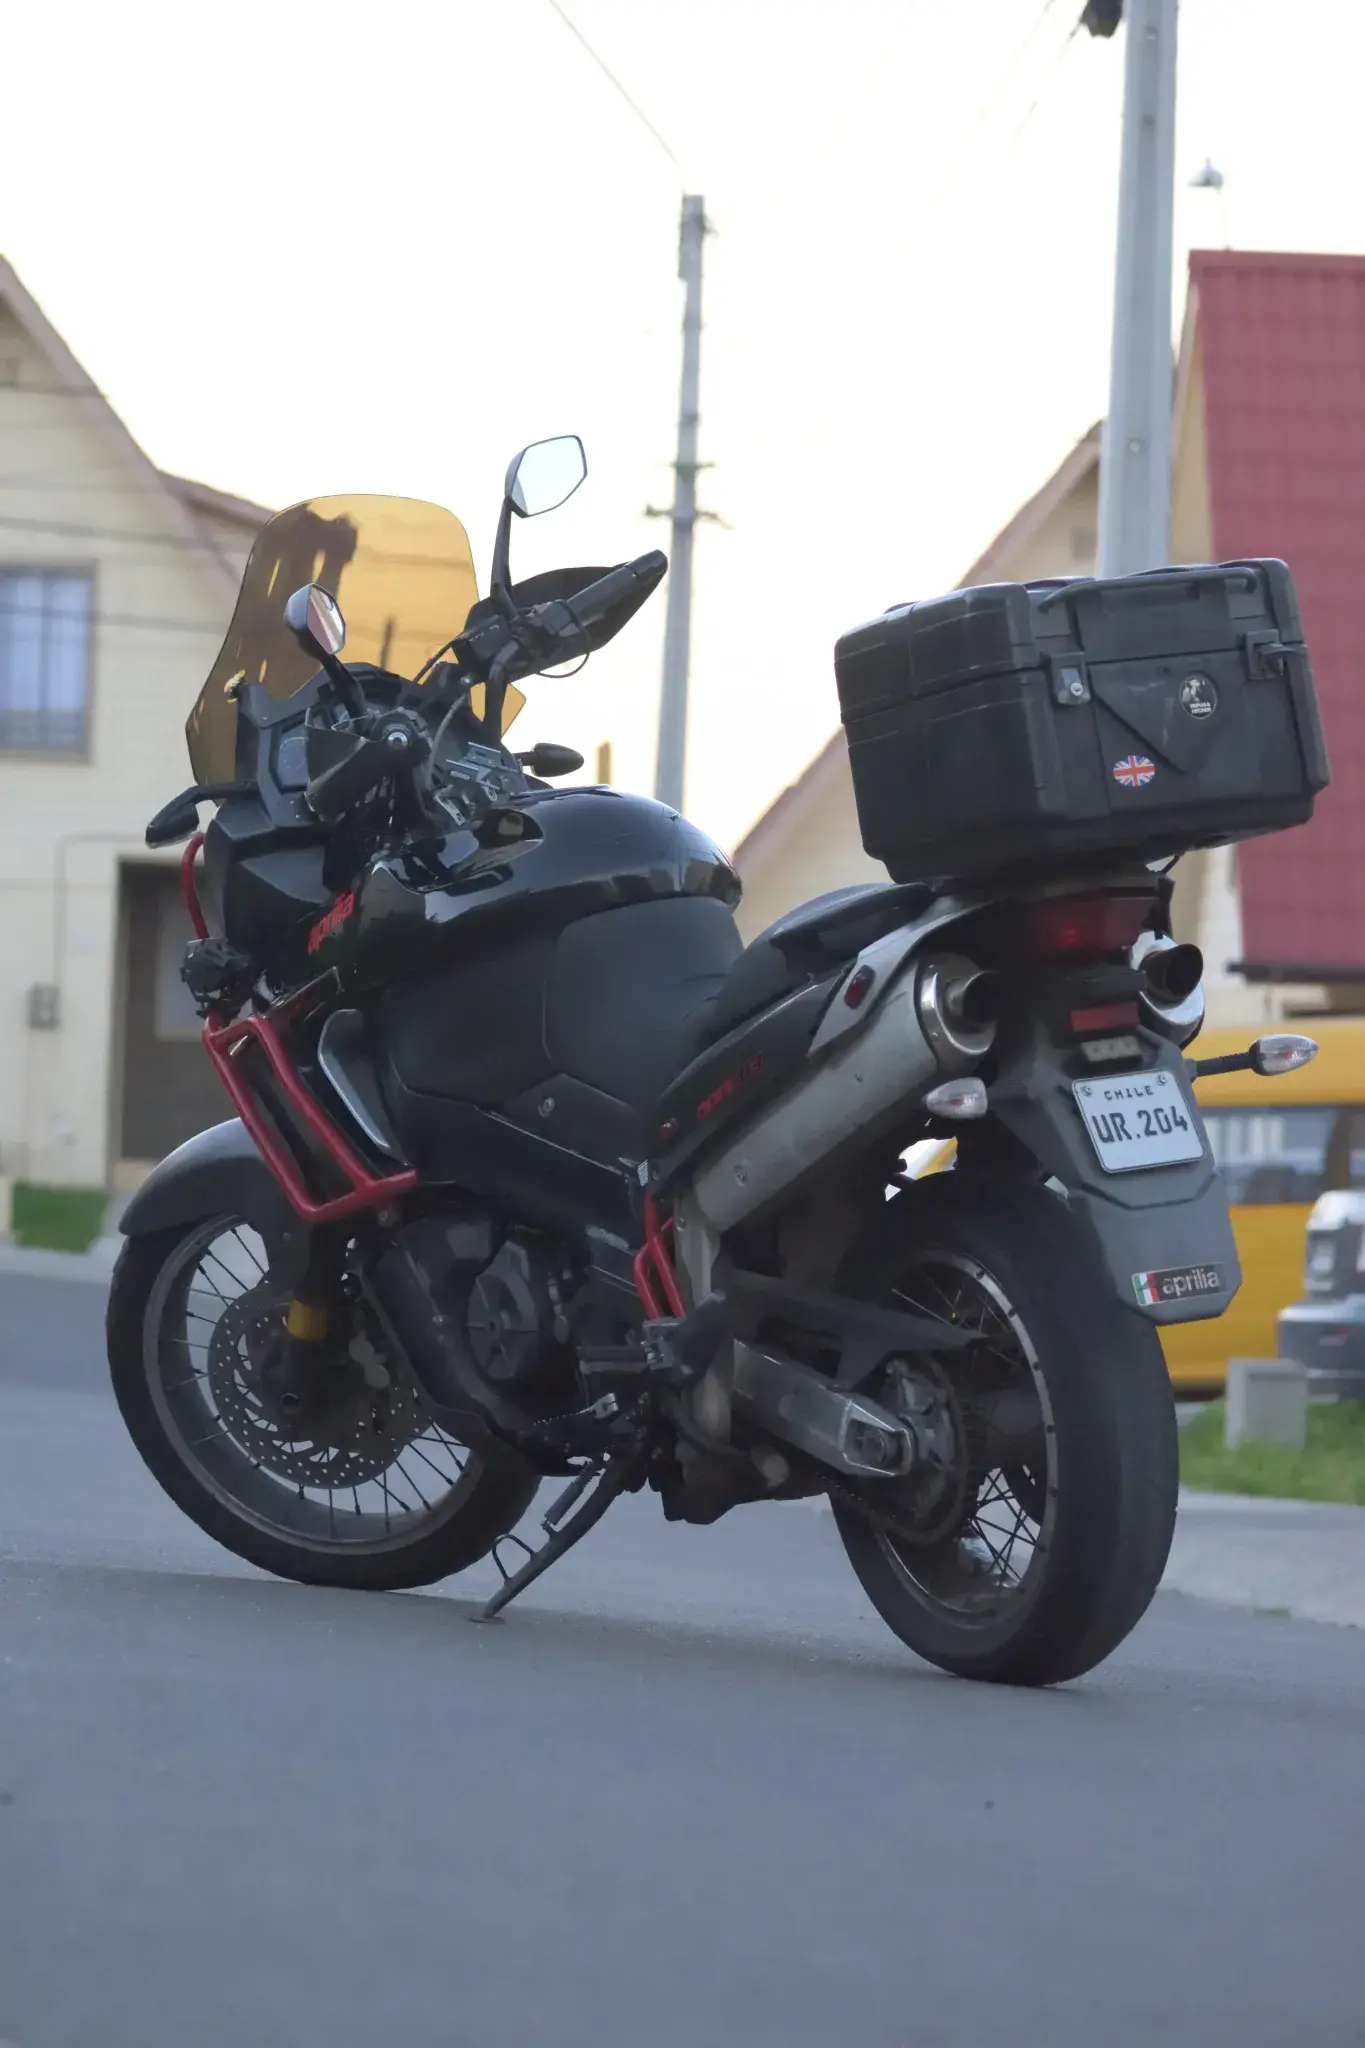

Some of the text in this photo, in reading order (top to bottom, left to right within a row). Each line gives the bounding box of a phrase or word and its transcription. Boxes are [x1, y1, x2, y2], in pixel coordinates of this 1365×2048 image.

[1104, 1085, 1154, 1100] CHILE
[1092, 1106, 1188, 1143] UR.204
[1162, 1268, 1219, 1296] aprilia
